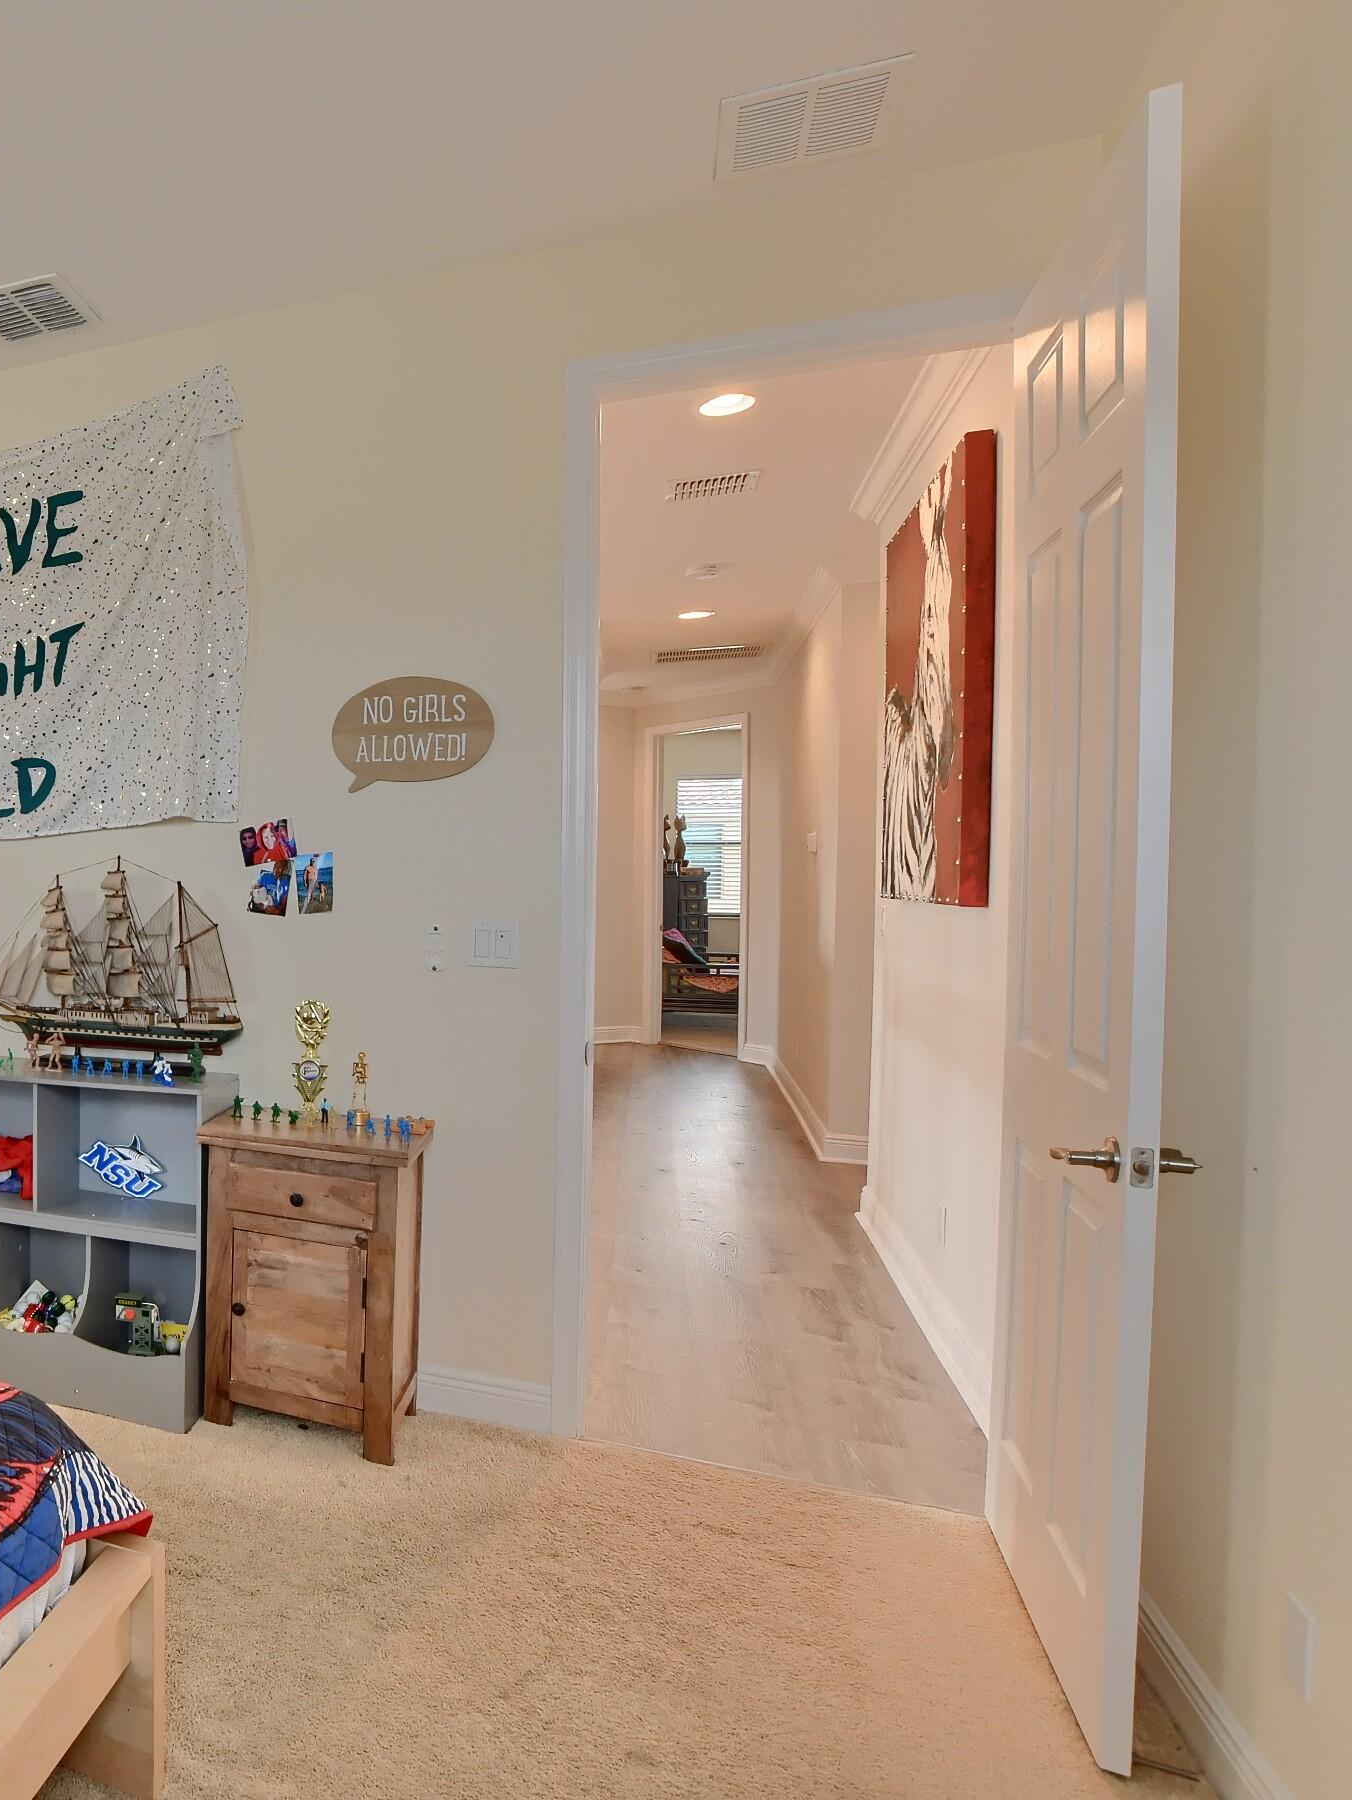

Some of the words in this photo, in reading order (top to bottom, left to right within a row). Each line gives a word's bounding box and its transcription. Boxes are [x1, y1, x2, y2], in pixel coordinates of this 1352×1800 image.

[363, 696, 393, 725] NO
[403, 694, 467, 723] GIRLS
[355, 733, 467, 763] ALLOWED!
[78, 1141, 162, 1198] NSU
